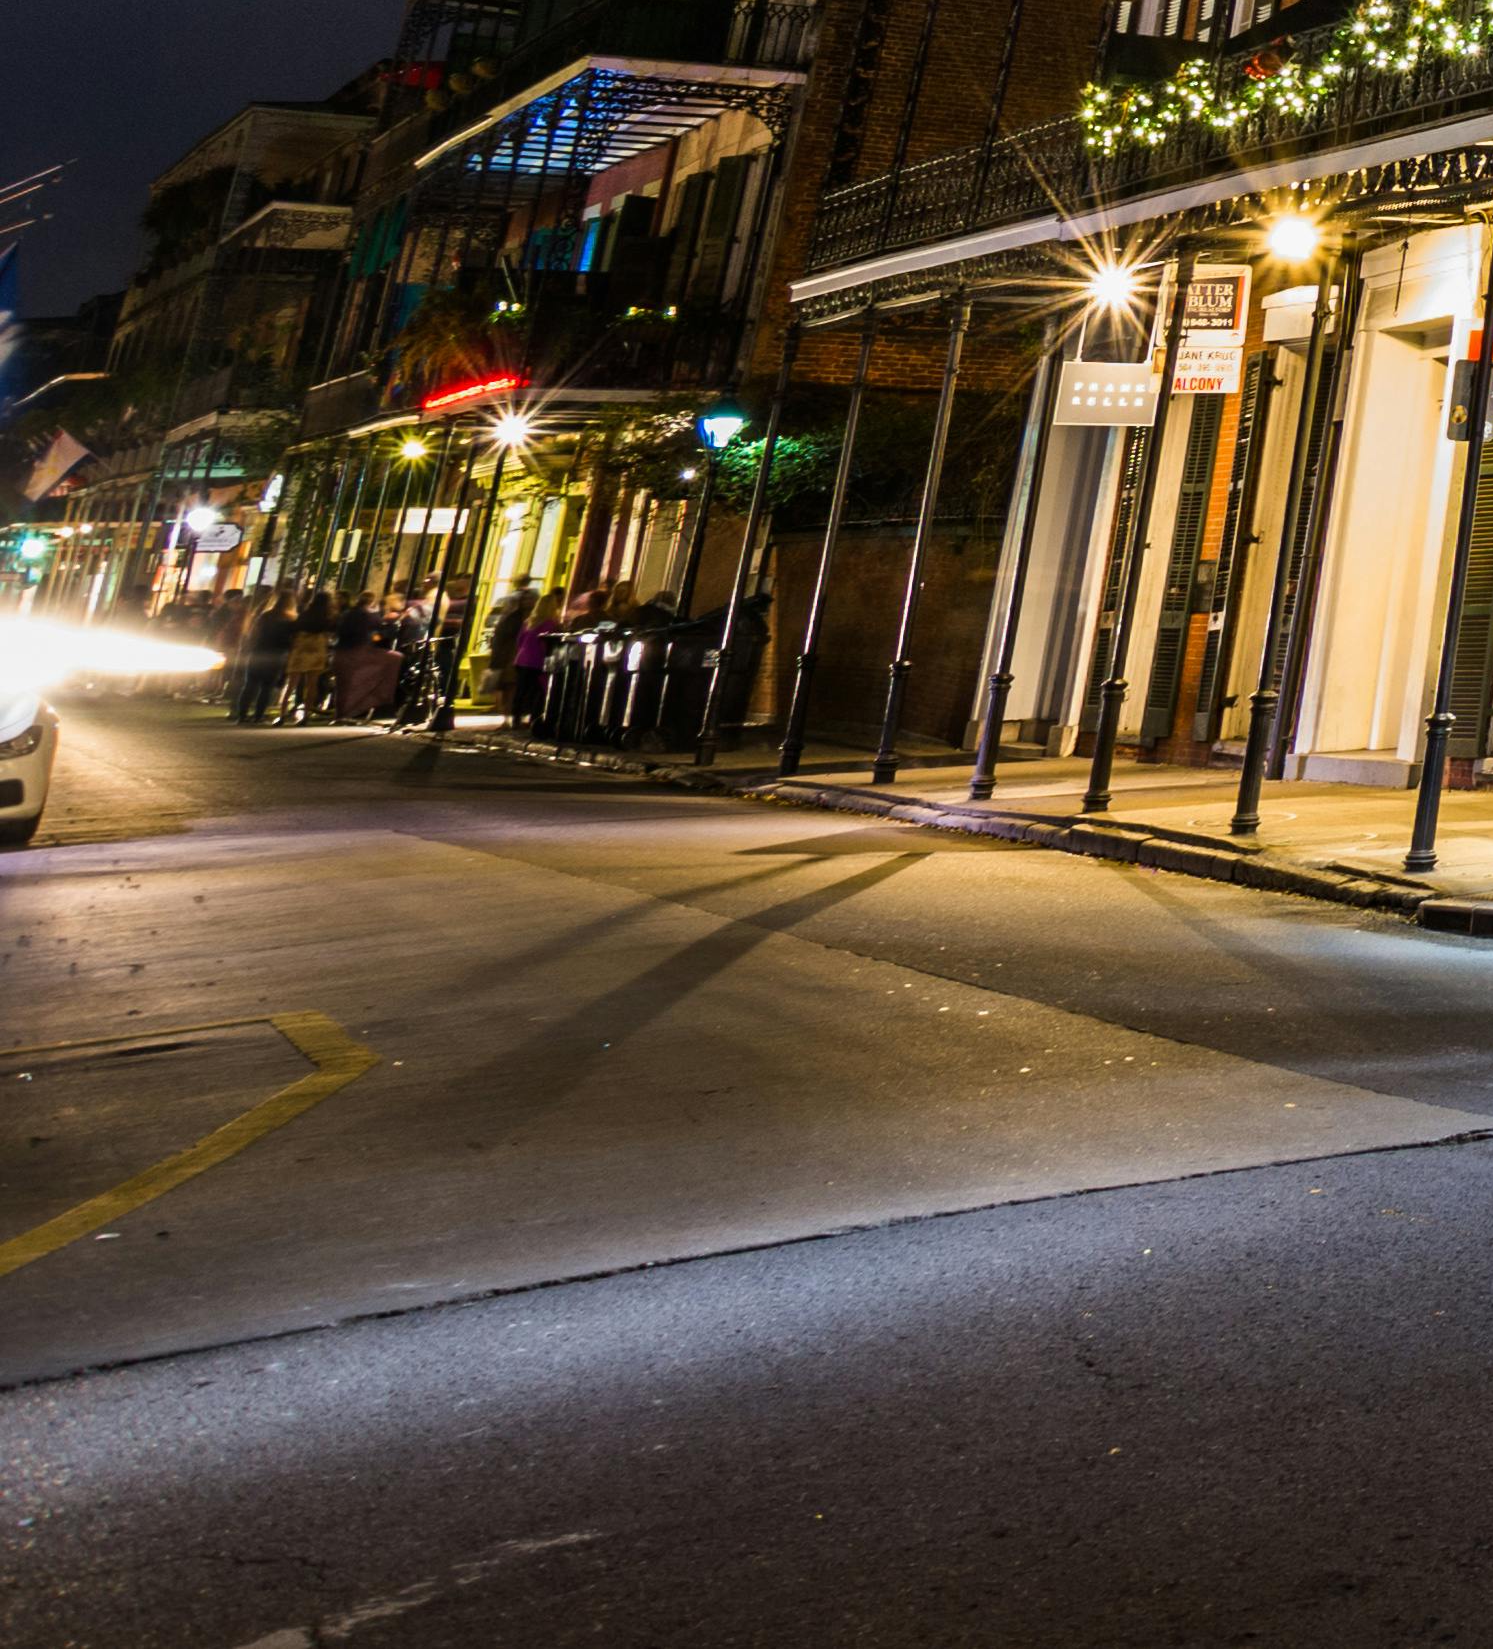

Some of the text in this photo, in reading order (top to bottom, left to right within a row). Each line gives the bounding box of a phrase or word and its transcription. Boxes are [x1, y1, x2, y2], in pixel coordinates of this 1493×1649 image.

[1188, 283, 1234, 296] ATTER
[1190, 295, 1233, 308] BLUM
[1174, 377, 1224, 390] ALCONY
